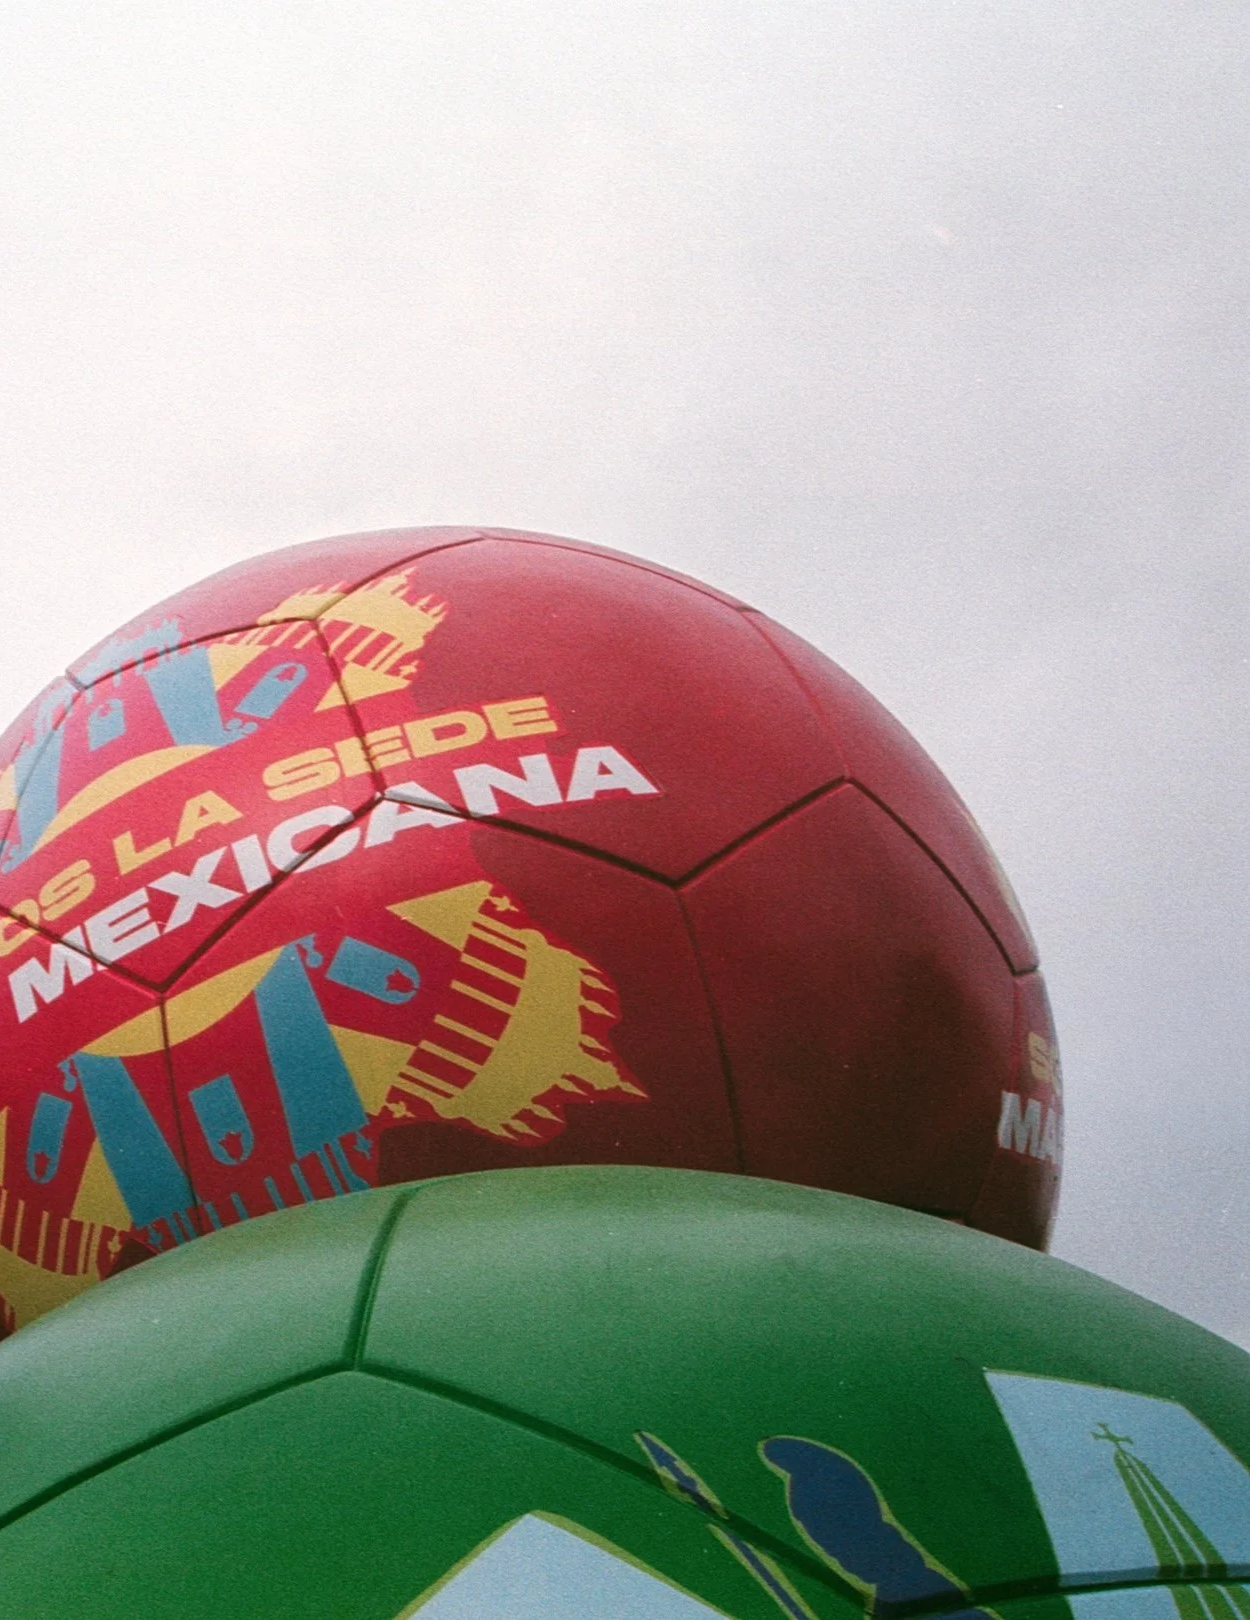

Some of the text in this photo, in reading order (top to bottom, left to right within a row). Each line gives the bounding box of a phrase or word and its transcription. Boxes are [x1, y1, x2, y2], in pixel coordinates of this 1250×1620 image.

[8, 746, 659, 1024] MEXICANA
[112, 790, 244, 876] LA
[262, 696, 558, 802] SEDE
